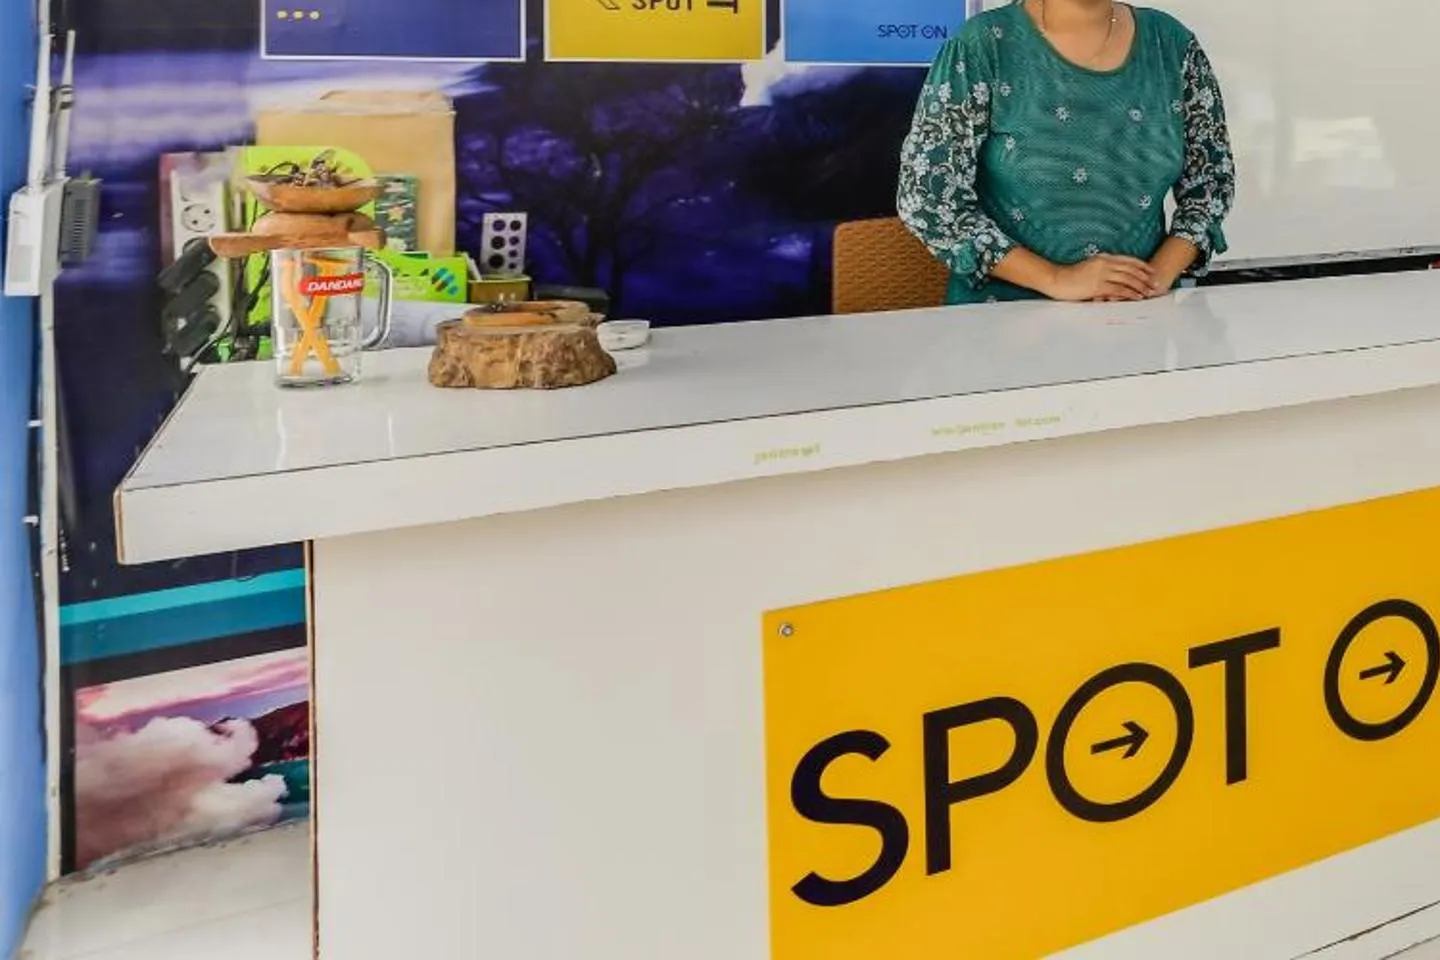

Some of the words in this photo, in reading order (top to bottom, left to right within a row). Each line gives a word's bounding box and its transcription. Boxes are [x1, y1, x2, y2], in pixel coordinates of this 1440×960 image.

[877, 24, 918, 39] SPOT
[921, 25, 948, 40] ON
[790, 626, 1281, 908] SPOT
